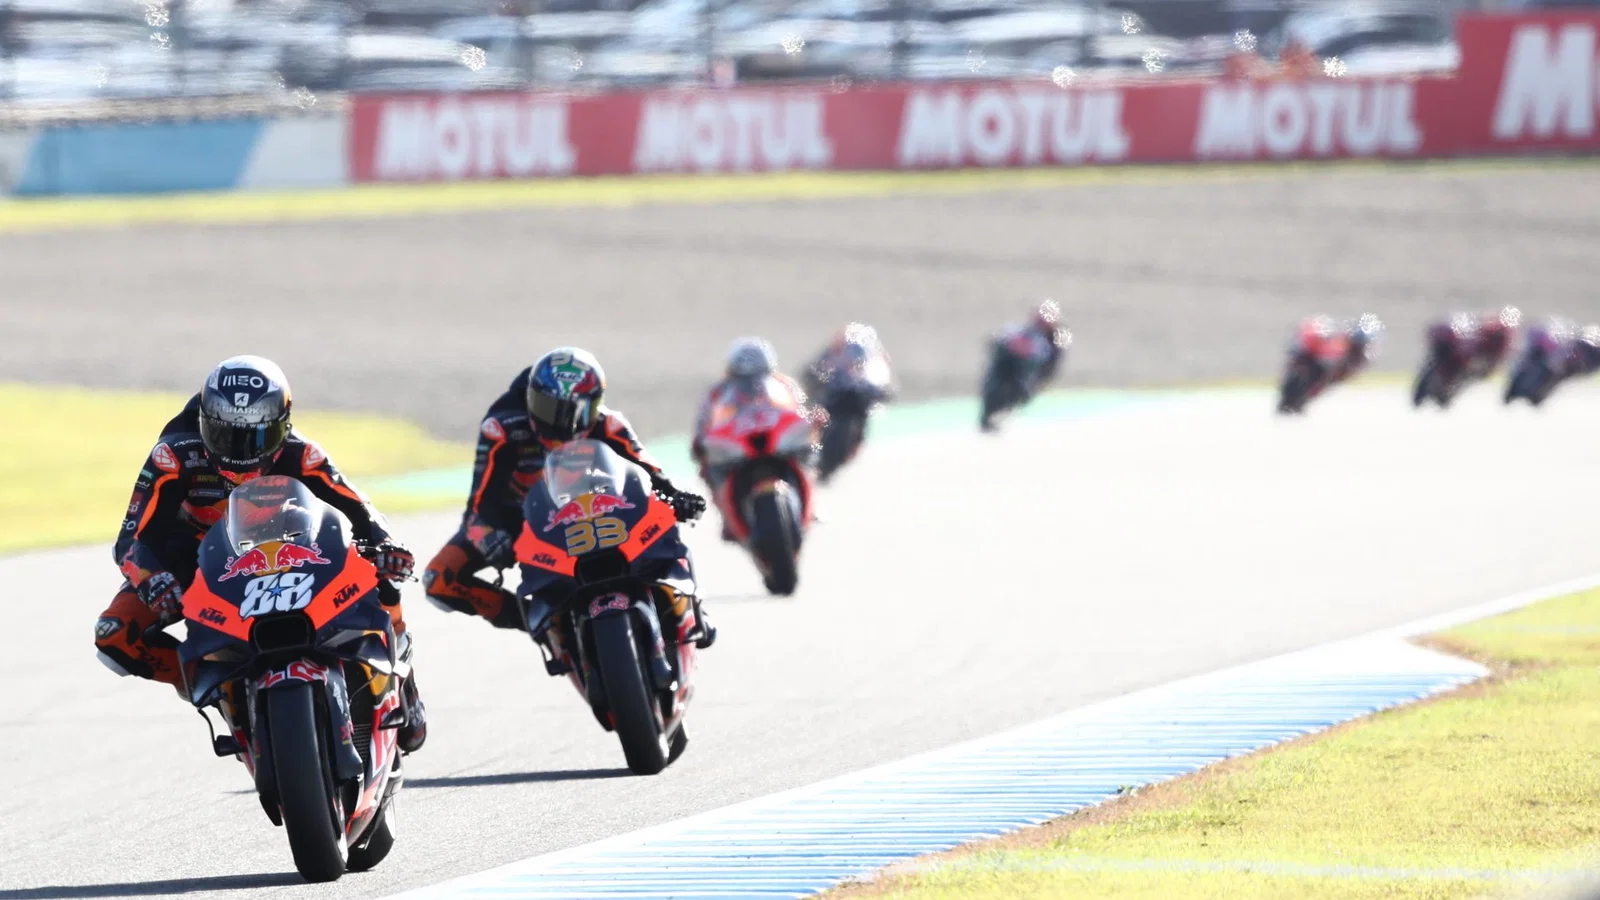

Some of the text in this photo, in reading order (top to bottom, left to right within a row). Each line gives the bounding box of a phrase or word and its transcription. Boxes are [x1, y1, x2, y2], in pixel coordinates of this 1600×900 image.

[632, 97, 834, 171] MOTUL
[897, 89, 1131, 167] MOTUL
[1195, 82, 1422, 157] MOTUL
[373, 101, 578, 177] MOTUL
[222, 375, 264, 388] MEO
[221, 405, 261, 415] SHARK
[564, 517, 629, 556] 33
[638, 523, 662, 546] KTM
[532, 551, 557, 568] KTM
[239, 573, 315, 619] 88
[332, 583, 360, 608] KTM
[198, 607, 228, 626] KTM
